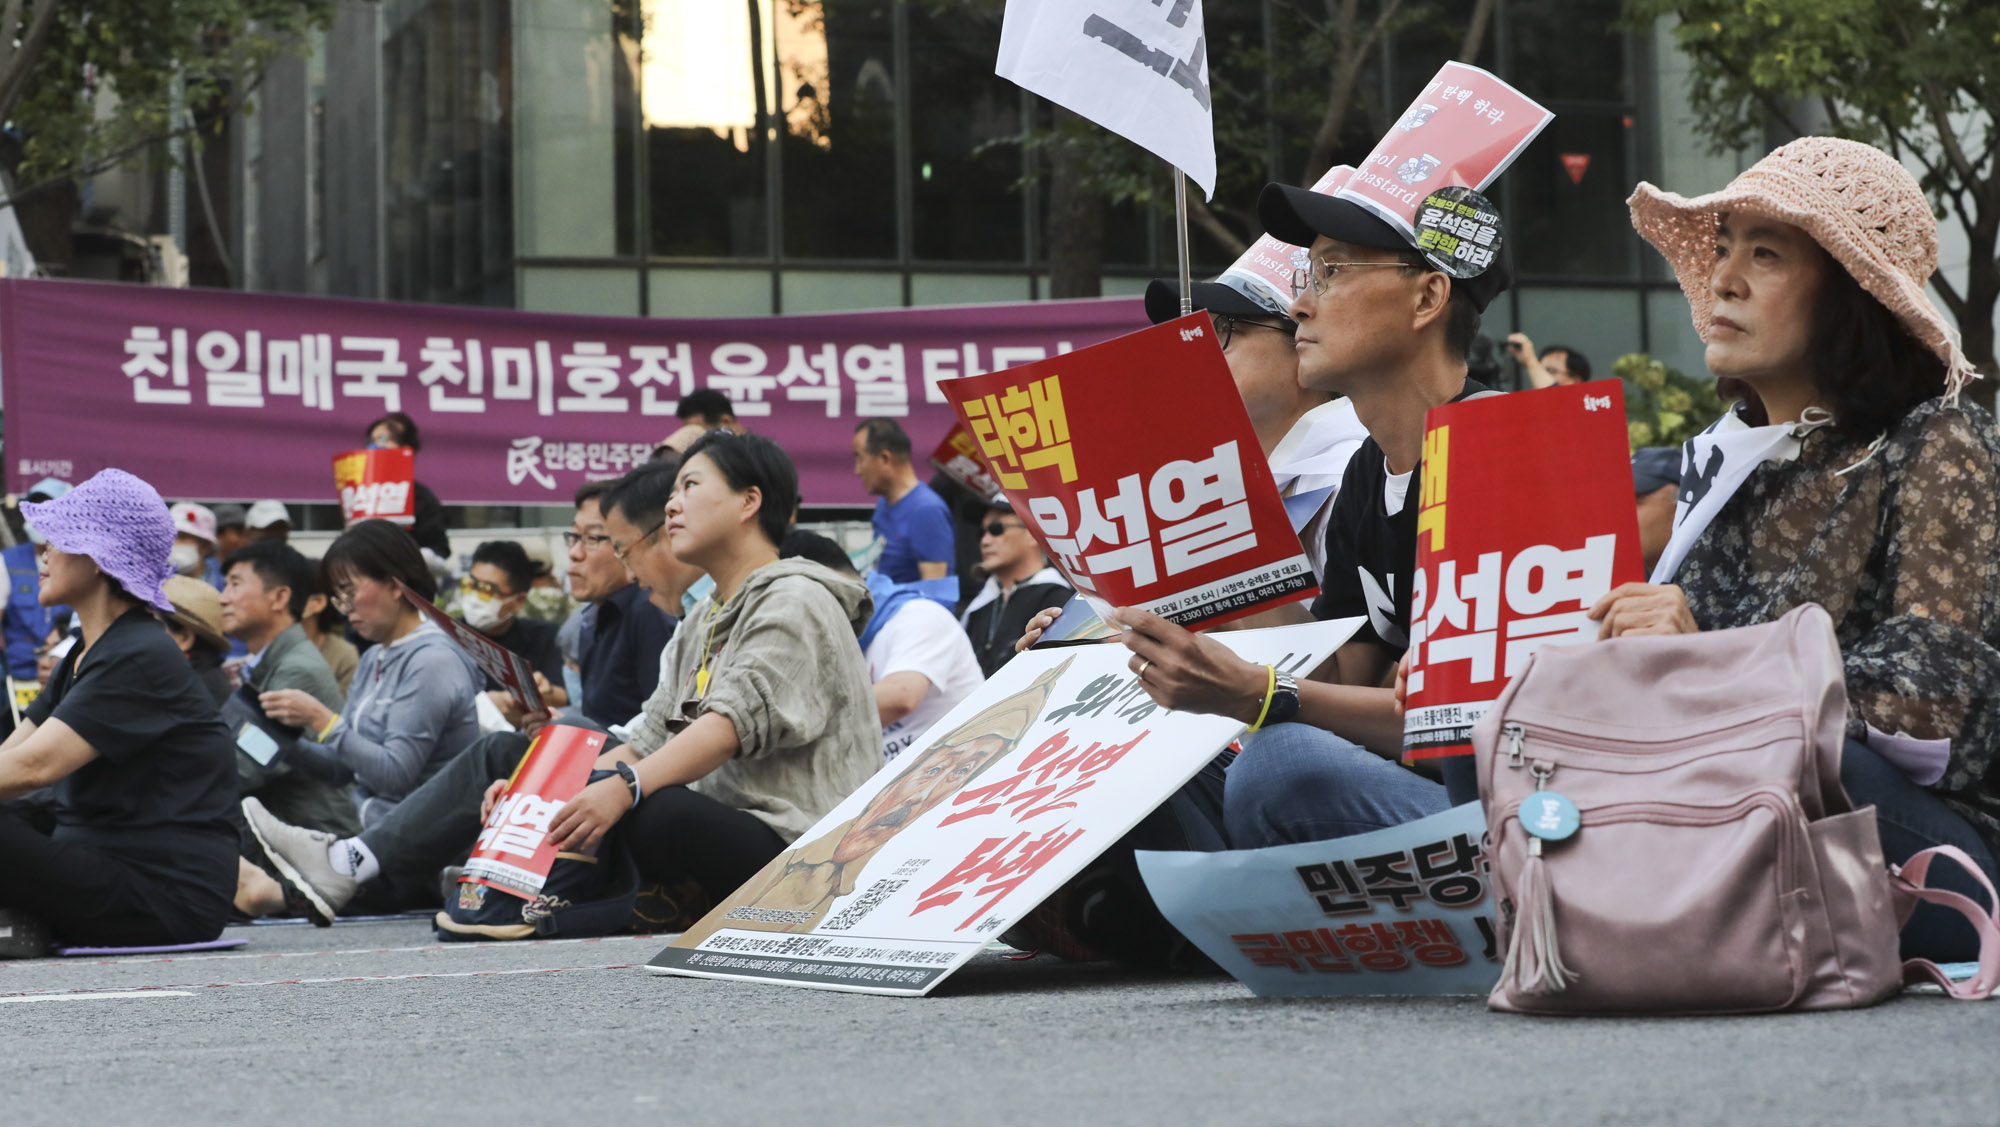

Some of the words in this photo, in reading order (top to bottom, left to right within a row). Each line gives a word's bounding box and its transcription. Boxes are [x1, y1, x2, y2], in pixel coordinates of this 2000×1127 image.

[1473, 98, 1505, 126] 하라
[1357, 167, 1417, 208] bastard.
[1417, 228, 1495, 268] 탄핵하라
[1420, 208, 1497, 247] 윤석열을
[121, 326, 408, 411] 친일매국
[417, 337, 696, 417] 친미호전
[706, 341, 909, 418] 윤석열
[542, 441, 656, 472] 민중민주당
[962, 374, 1079, 490] 탄핵
[506, 435, 557, 491] 民
[1028, 439, 1259, 592] 윤석열
[1153, 601, 1179, 616] 토요일
[1183, 594, 1201, 607] 오후
[1200, 590, 1216, 601] 6시
[1221, 572, 1272, 595] 시청역-숭례문
[1271, 569, 1281, 580] 앞
[1281, 562, 1303, 575] 대로)
[1168, 609, 1202, 625] 07-3300
[1202, 604, 1215, 617] (한
[1232, 594, 1246, 606] 1만
[1246, 591, 1259, 603] 원,
[1258, 585, 1277, 597] 여러
[1275, 582, 1286, 592] 번
[1286, 575, 1306, 589] 가능)
[936, 728, 1151, 828] 윤석열
[908, 819, 1086, 932] 탄핵
[704, 936, 734, 947] 윤석열
[722, 937, 748, 950] 퇴진,
[739, 939, 768, 950] 김건희
[757, 940, 781, 951] 특검
[771, 937, 833, 955] 촛불대행진
[1230, 918, 1467, 974] 국민항쟁
